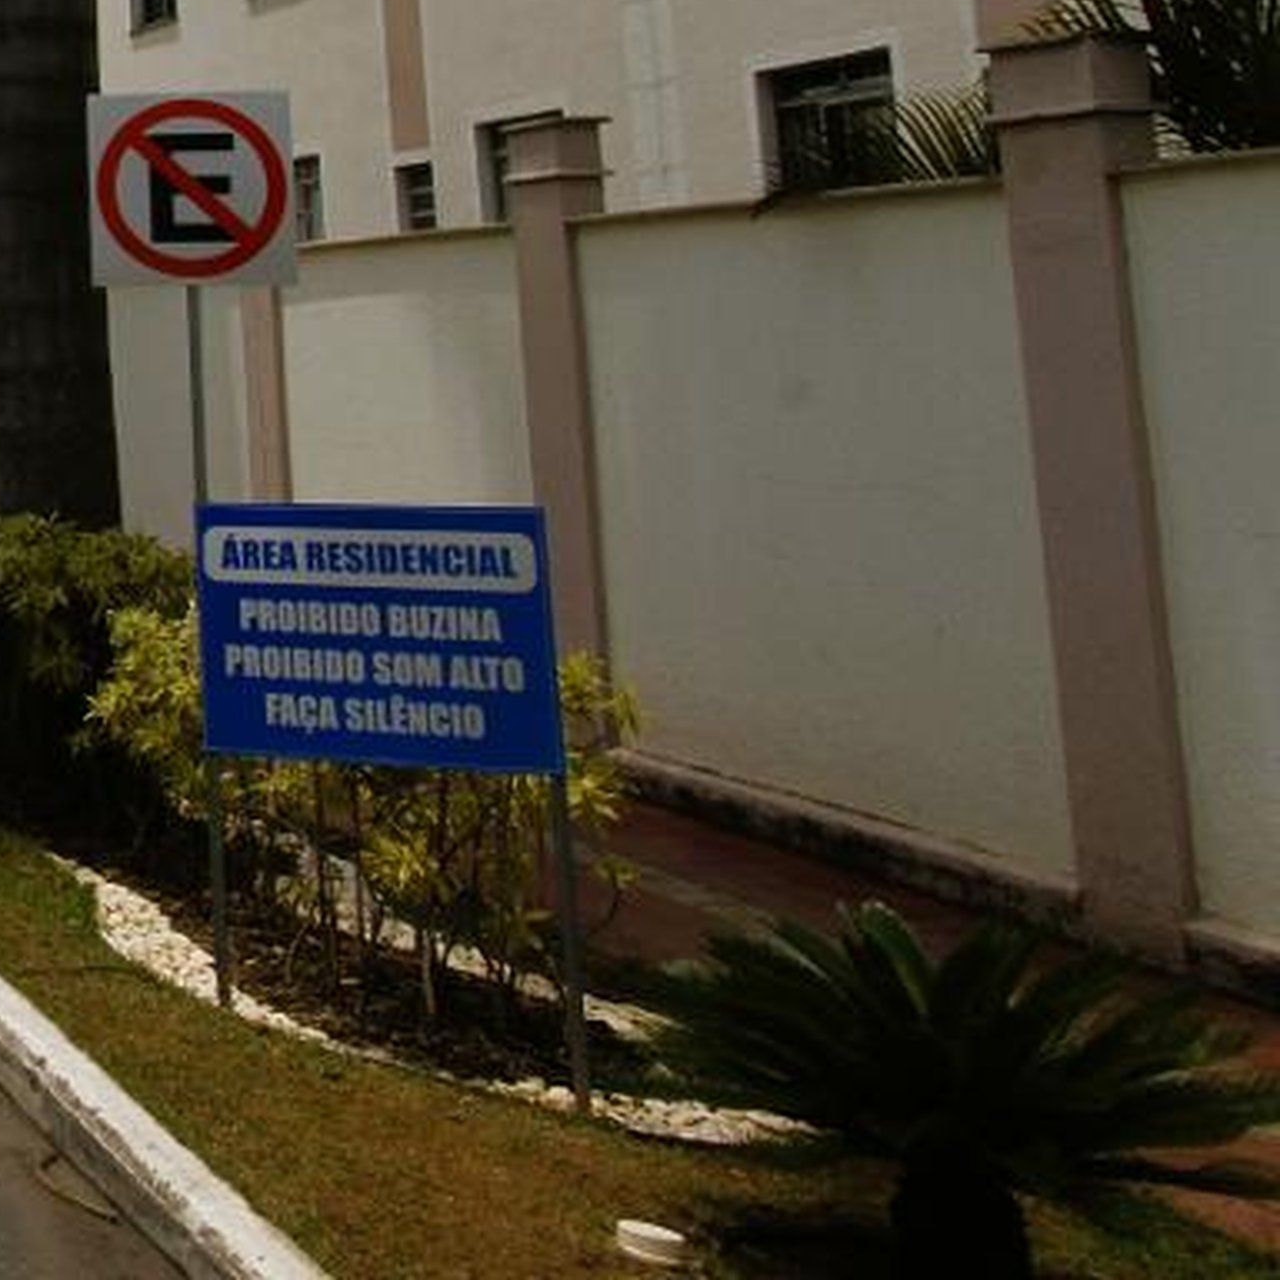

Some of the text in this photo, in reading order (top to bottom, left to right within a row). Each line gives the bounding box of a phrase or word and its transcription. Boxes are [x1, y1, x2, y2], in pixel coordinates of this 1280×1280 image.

[149, 133, 237, 243] E
[221, 533, 519, 578] ÁREA RESIDENCIAL
[240, 598, 502, 641] PROIBIDO BUZINA
[224, 644, 525, 692] PROIBIDO SOM ALTO
[265, 693, 486, 739] FAÇA SILÊNCIO
